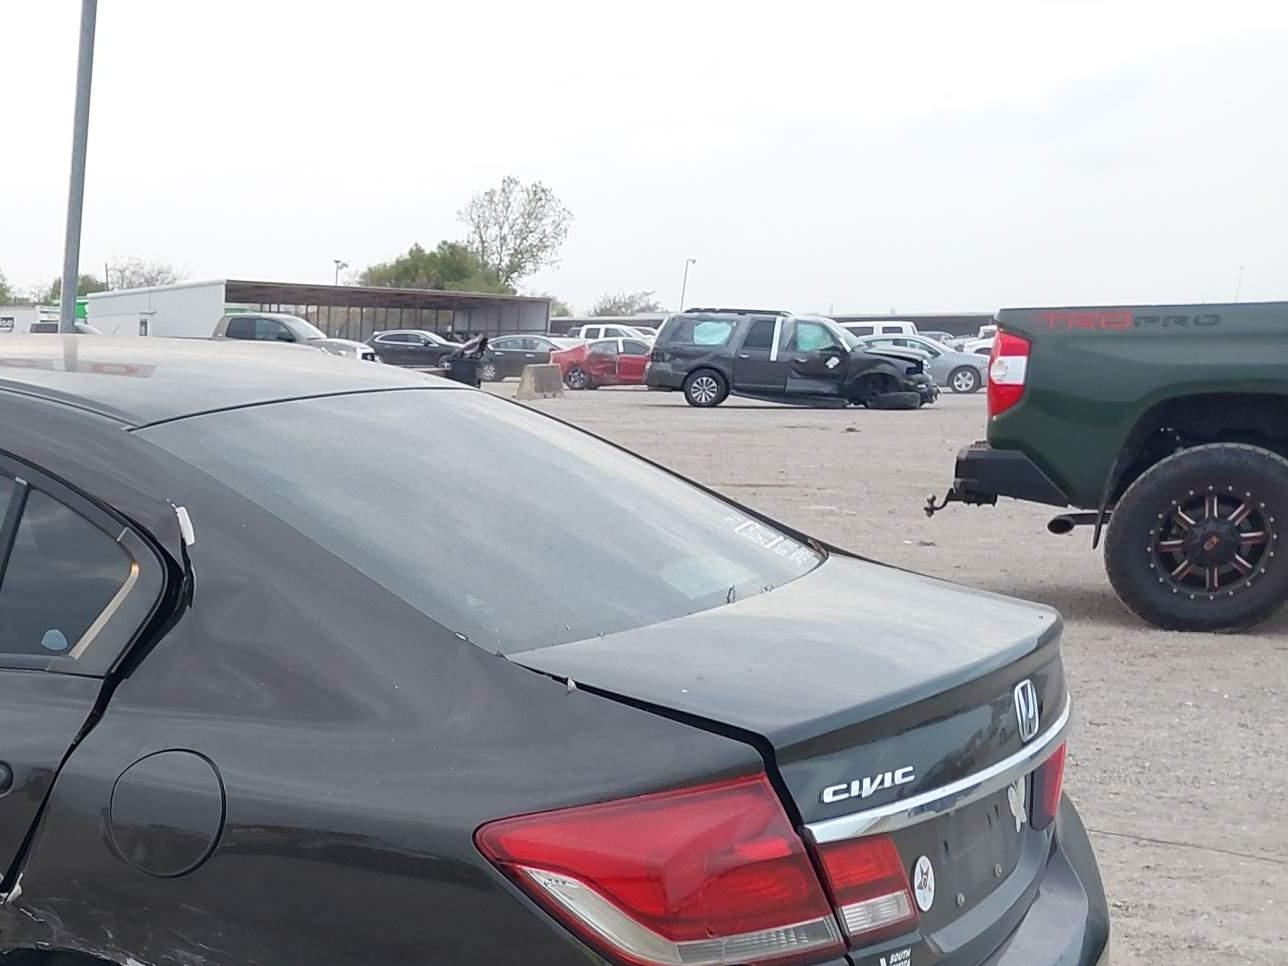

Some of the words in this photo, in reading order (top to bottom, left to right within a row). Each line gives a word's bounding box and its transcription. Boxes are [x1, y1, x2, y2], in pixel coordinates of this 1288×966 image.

[1133, 313, 1221, 328] PRO
[823, 765, 915, 804] CIVIC
[890, 948, 911, 964] SOUTH
